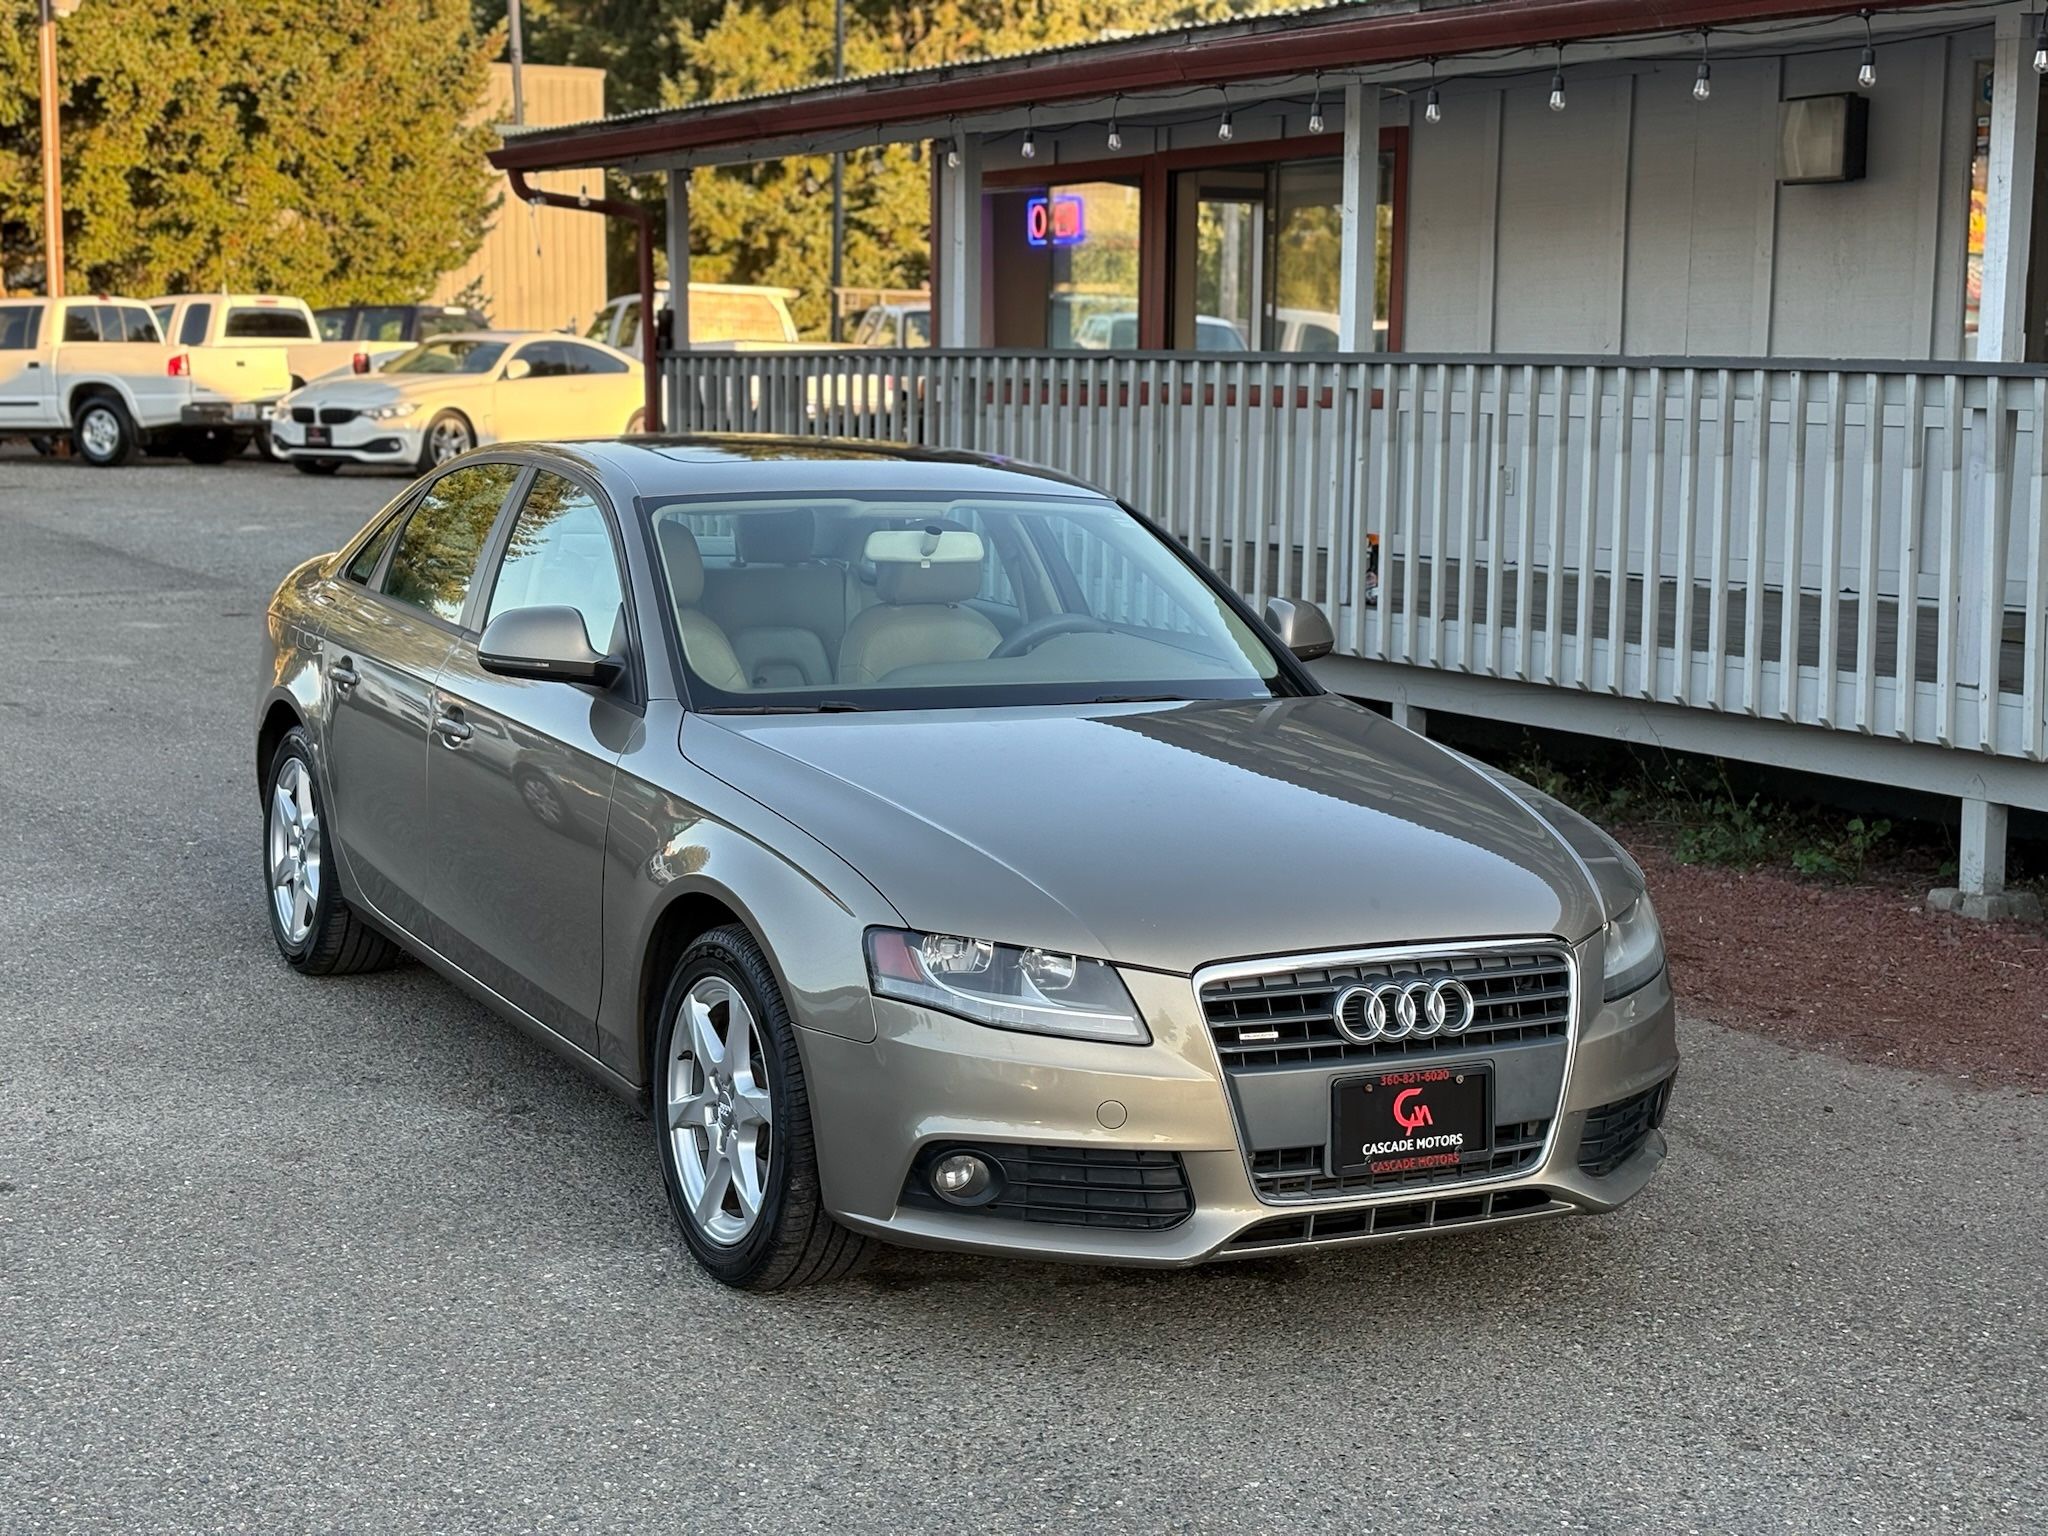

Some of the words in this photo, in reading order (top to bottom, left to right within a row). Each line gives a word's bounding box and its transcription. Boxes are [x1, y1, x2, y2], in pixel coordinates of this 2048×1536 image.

[1380, 1070, 1450, 1086] 360-821-6020
[1362, 1139, 1414, 1155] CASCADE
[1416, 1133, 1463, 1150] MOTORS
[1371, 1159, 1417, 1173] CASCADE
[1418, 1153, 1460, 1168] MOTORS
